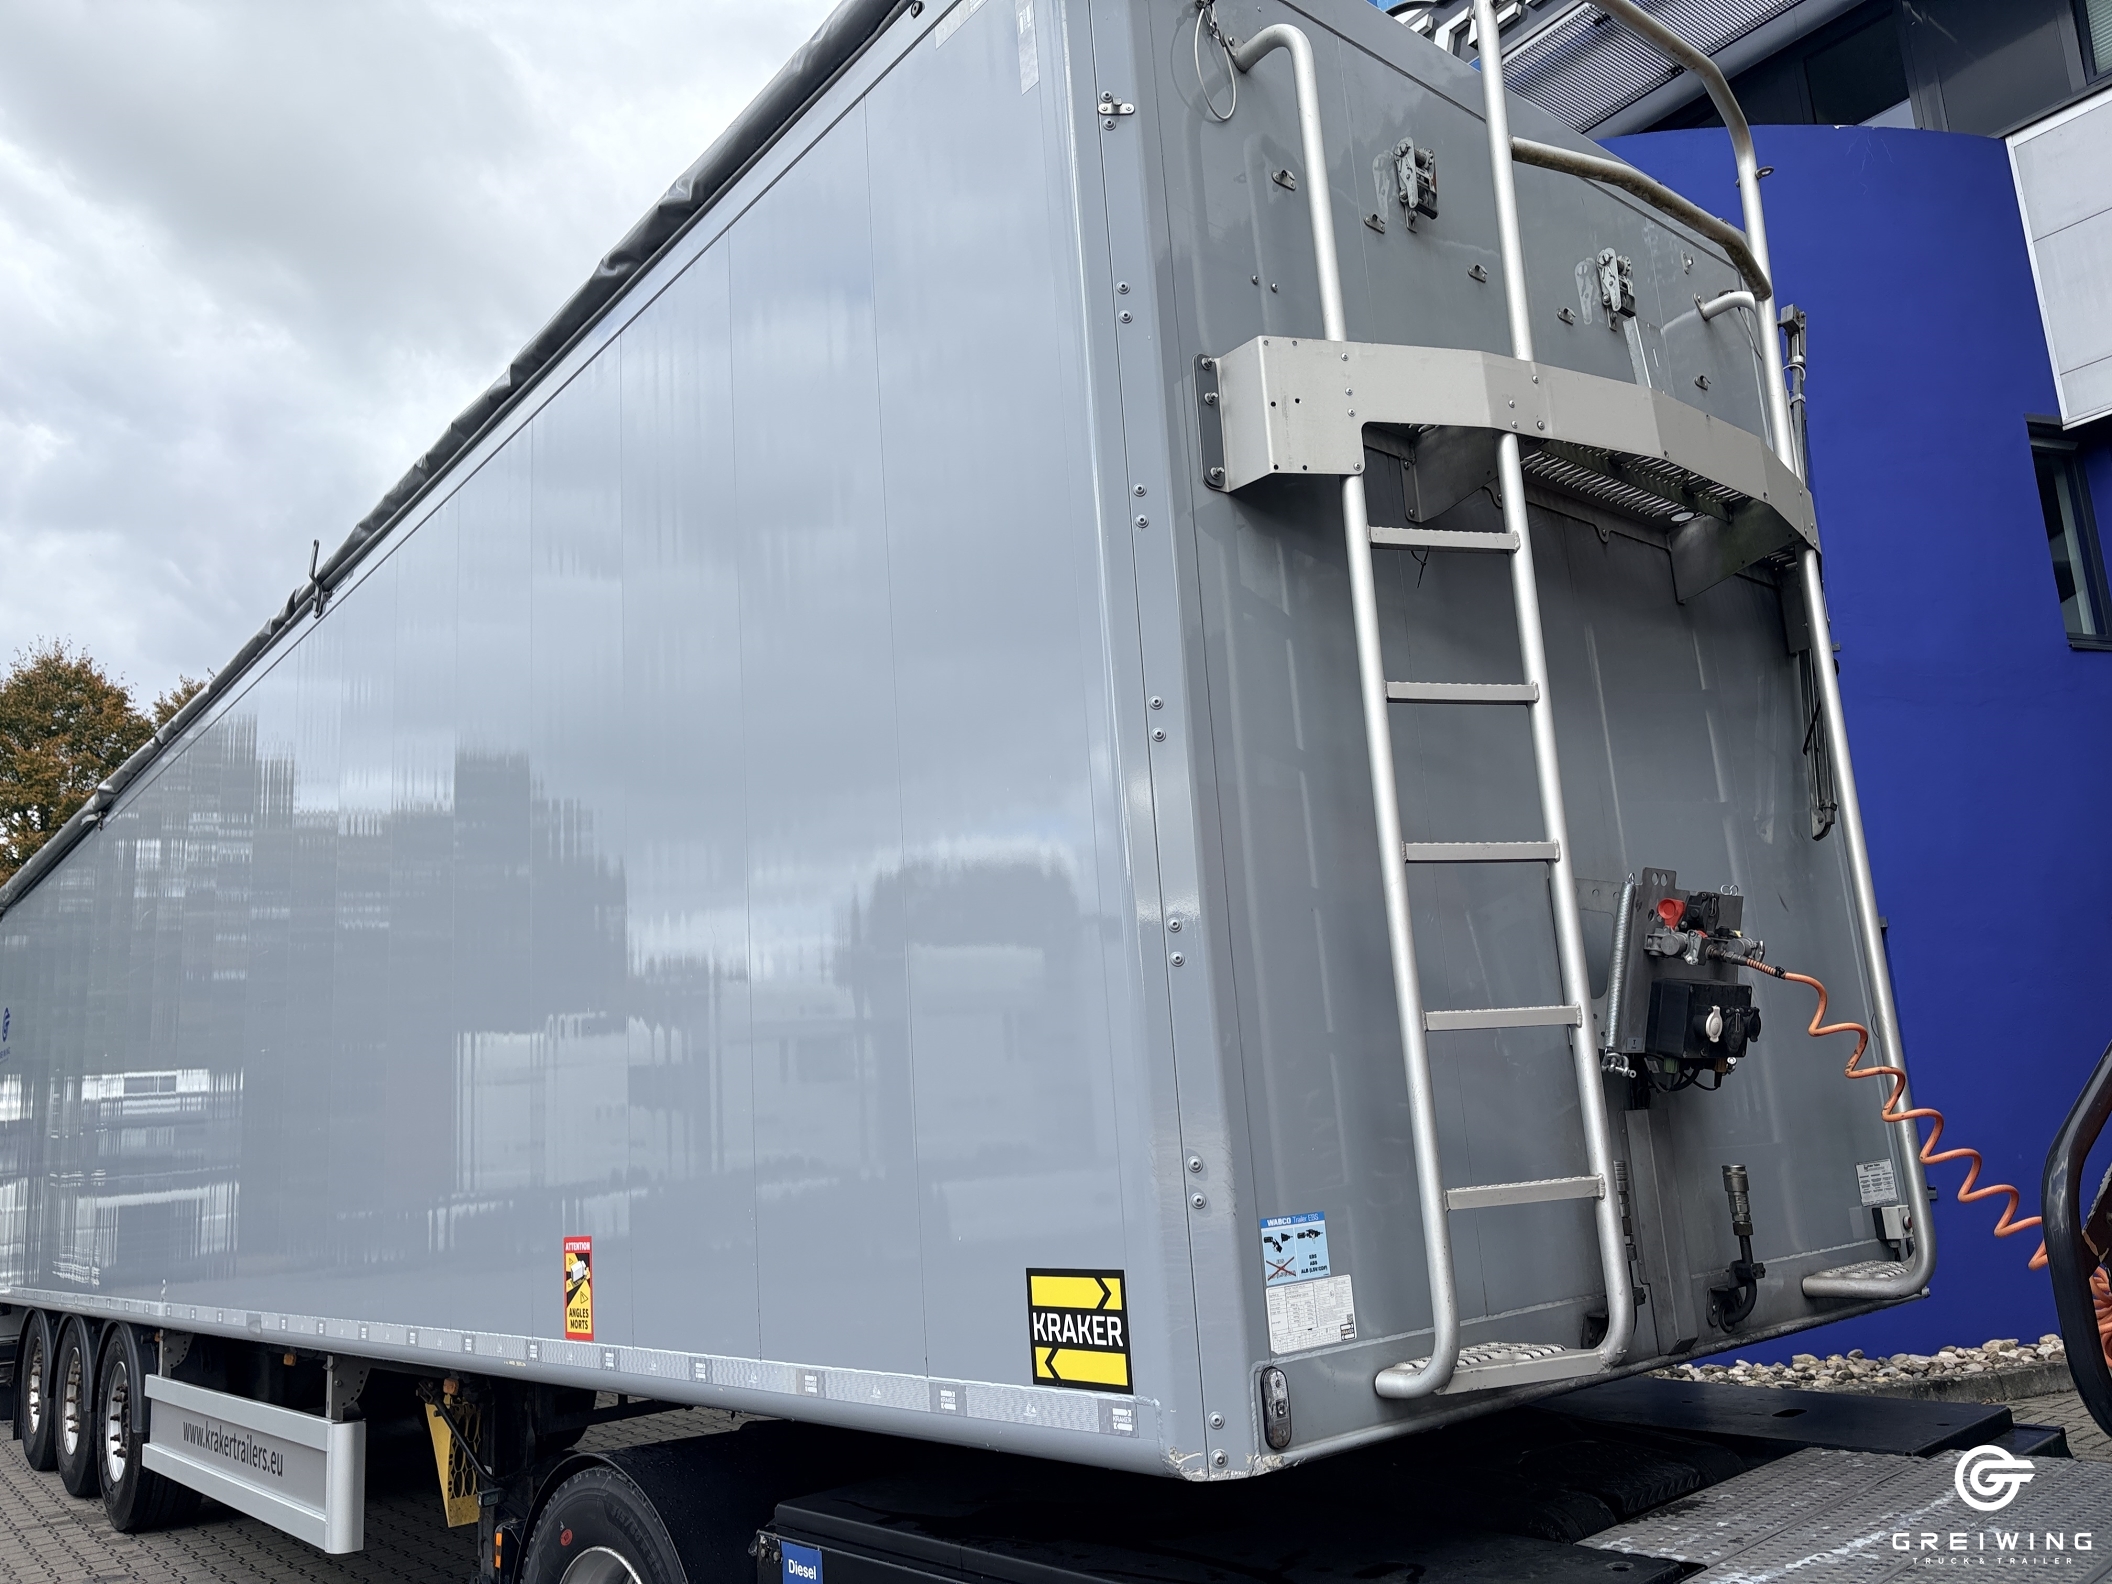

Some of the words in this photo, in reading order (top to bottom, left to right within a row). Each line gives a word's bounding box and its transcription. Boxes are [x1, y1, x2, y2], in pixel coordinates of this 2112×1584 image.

[1266, 1217, 1291, 1226] WABCO
[1291, 1214, 1308, 1224] Trailer
[1307, 1213, 1319, 1222] EBS
[565, 1242, 590, 1251] ATTENTION
[569, 1307, 589, 1319] ANGLES
[570, 1319, 589, 1330] MORTS
[1032, 1311, 1124, 1347] KRAKER
[1112, 1415, 1132, 1424] KRAKER
[183, 1420, 283, 1477] www.krakertrailers.eu
[787, 1557, 817, 1580] Diesel
